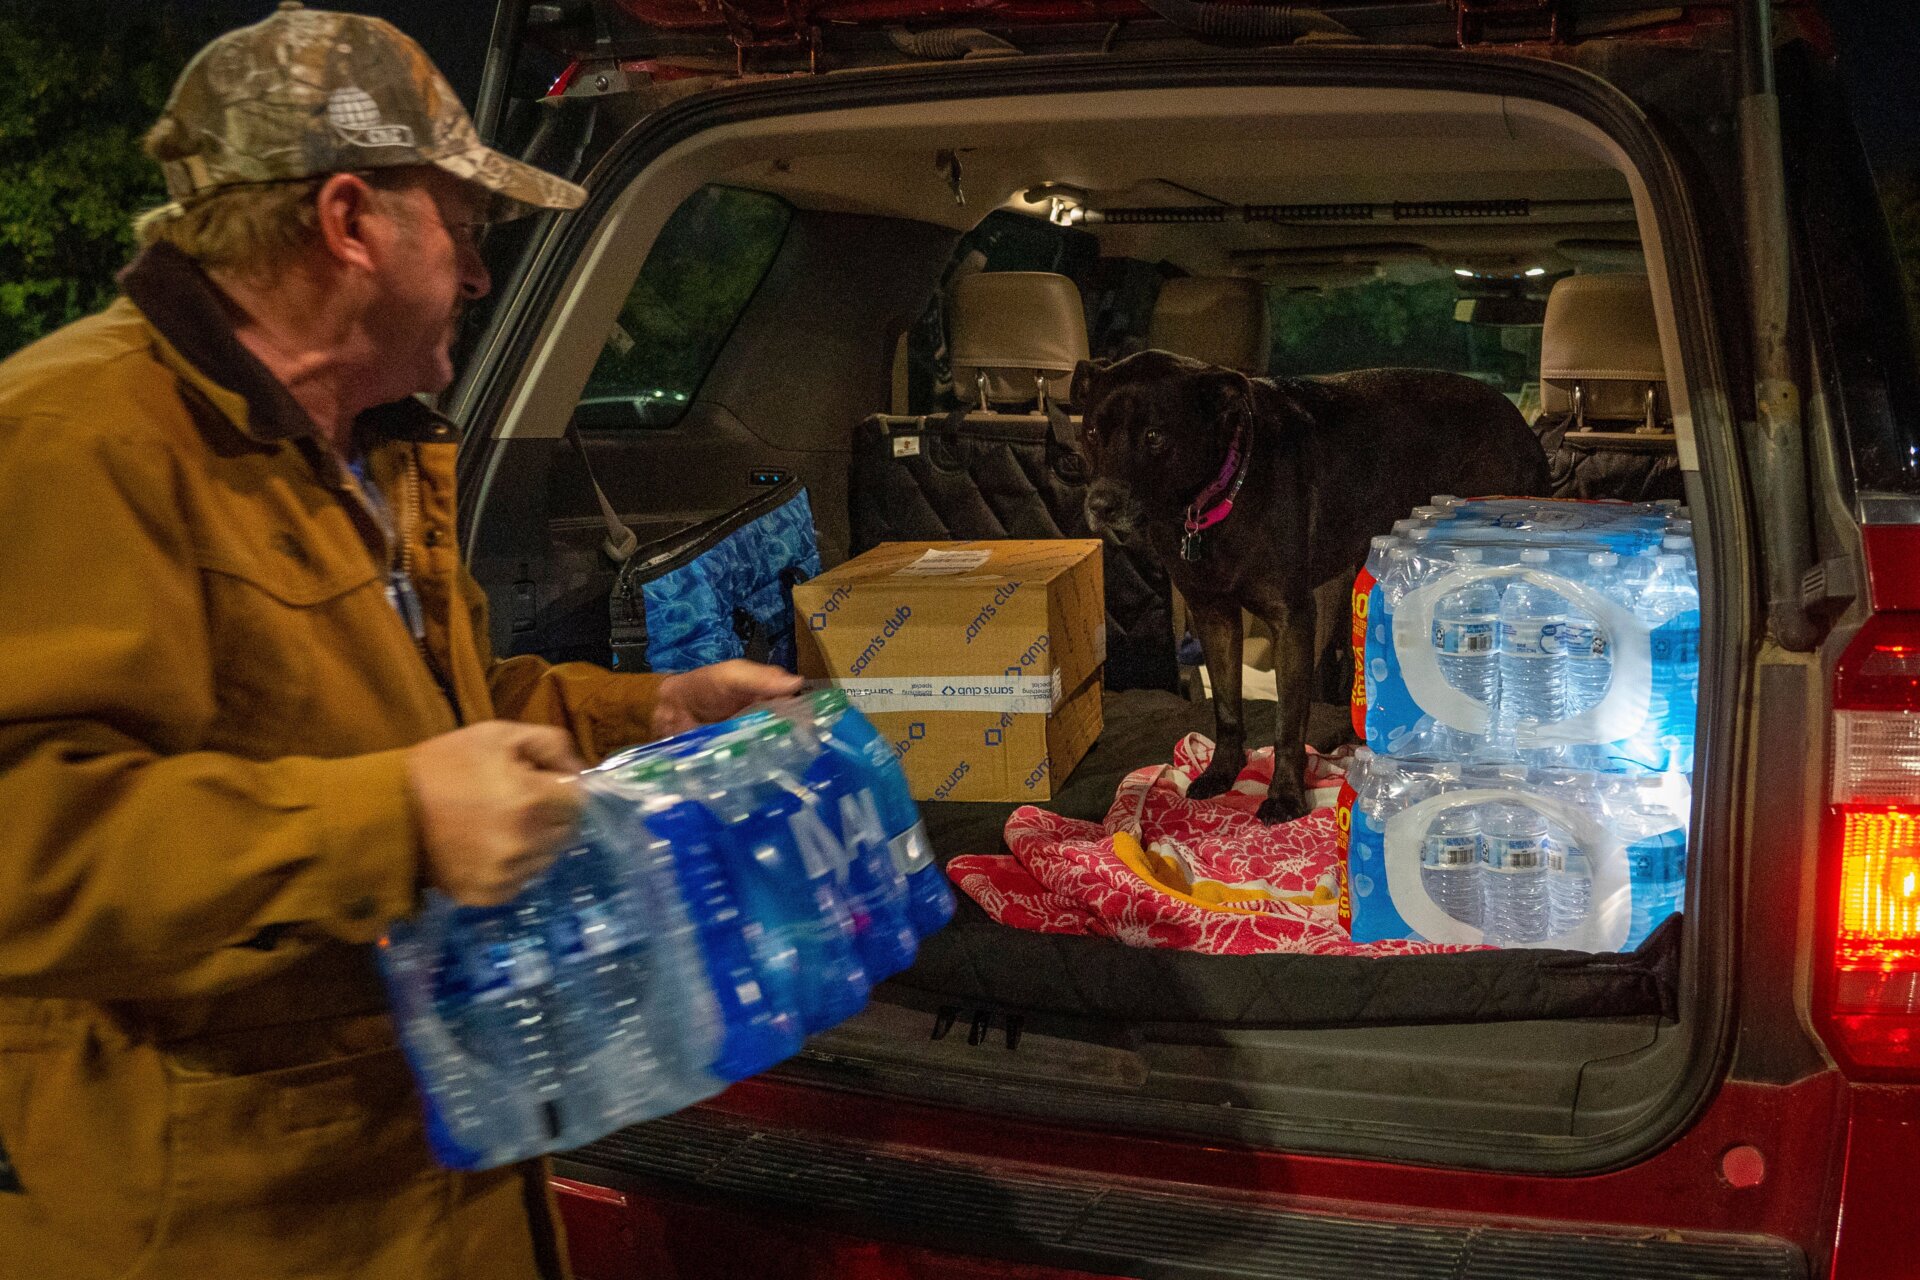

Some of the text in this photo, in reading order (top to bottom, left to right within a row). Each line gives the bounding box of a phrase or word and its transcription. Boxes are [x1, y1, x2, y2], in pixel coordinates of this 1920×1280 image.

[850, 605, 912, 677] sam's club
[1020, 635, 1051, 667] club
[957, 686, 1014, 696] sam's club
[1355, 646, 1367, 706] VALUE
[934, 760, 970, 799] sam's
[1339, 860, 1351, 919] VALUE
